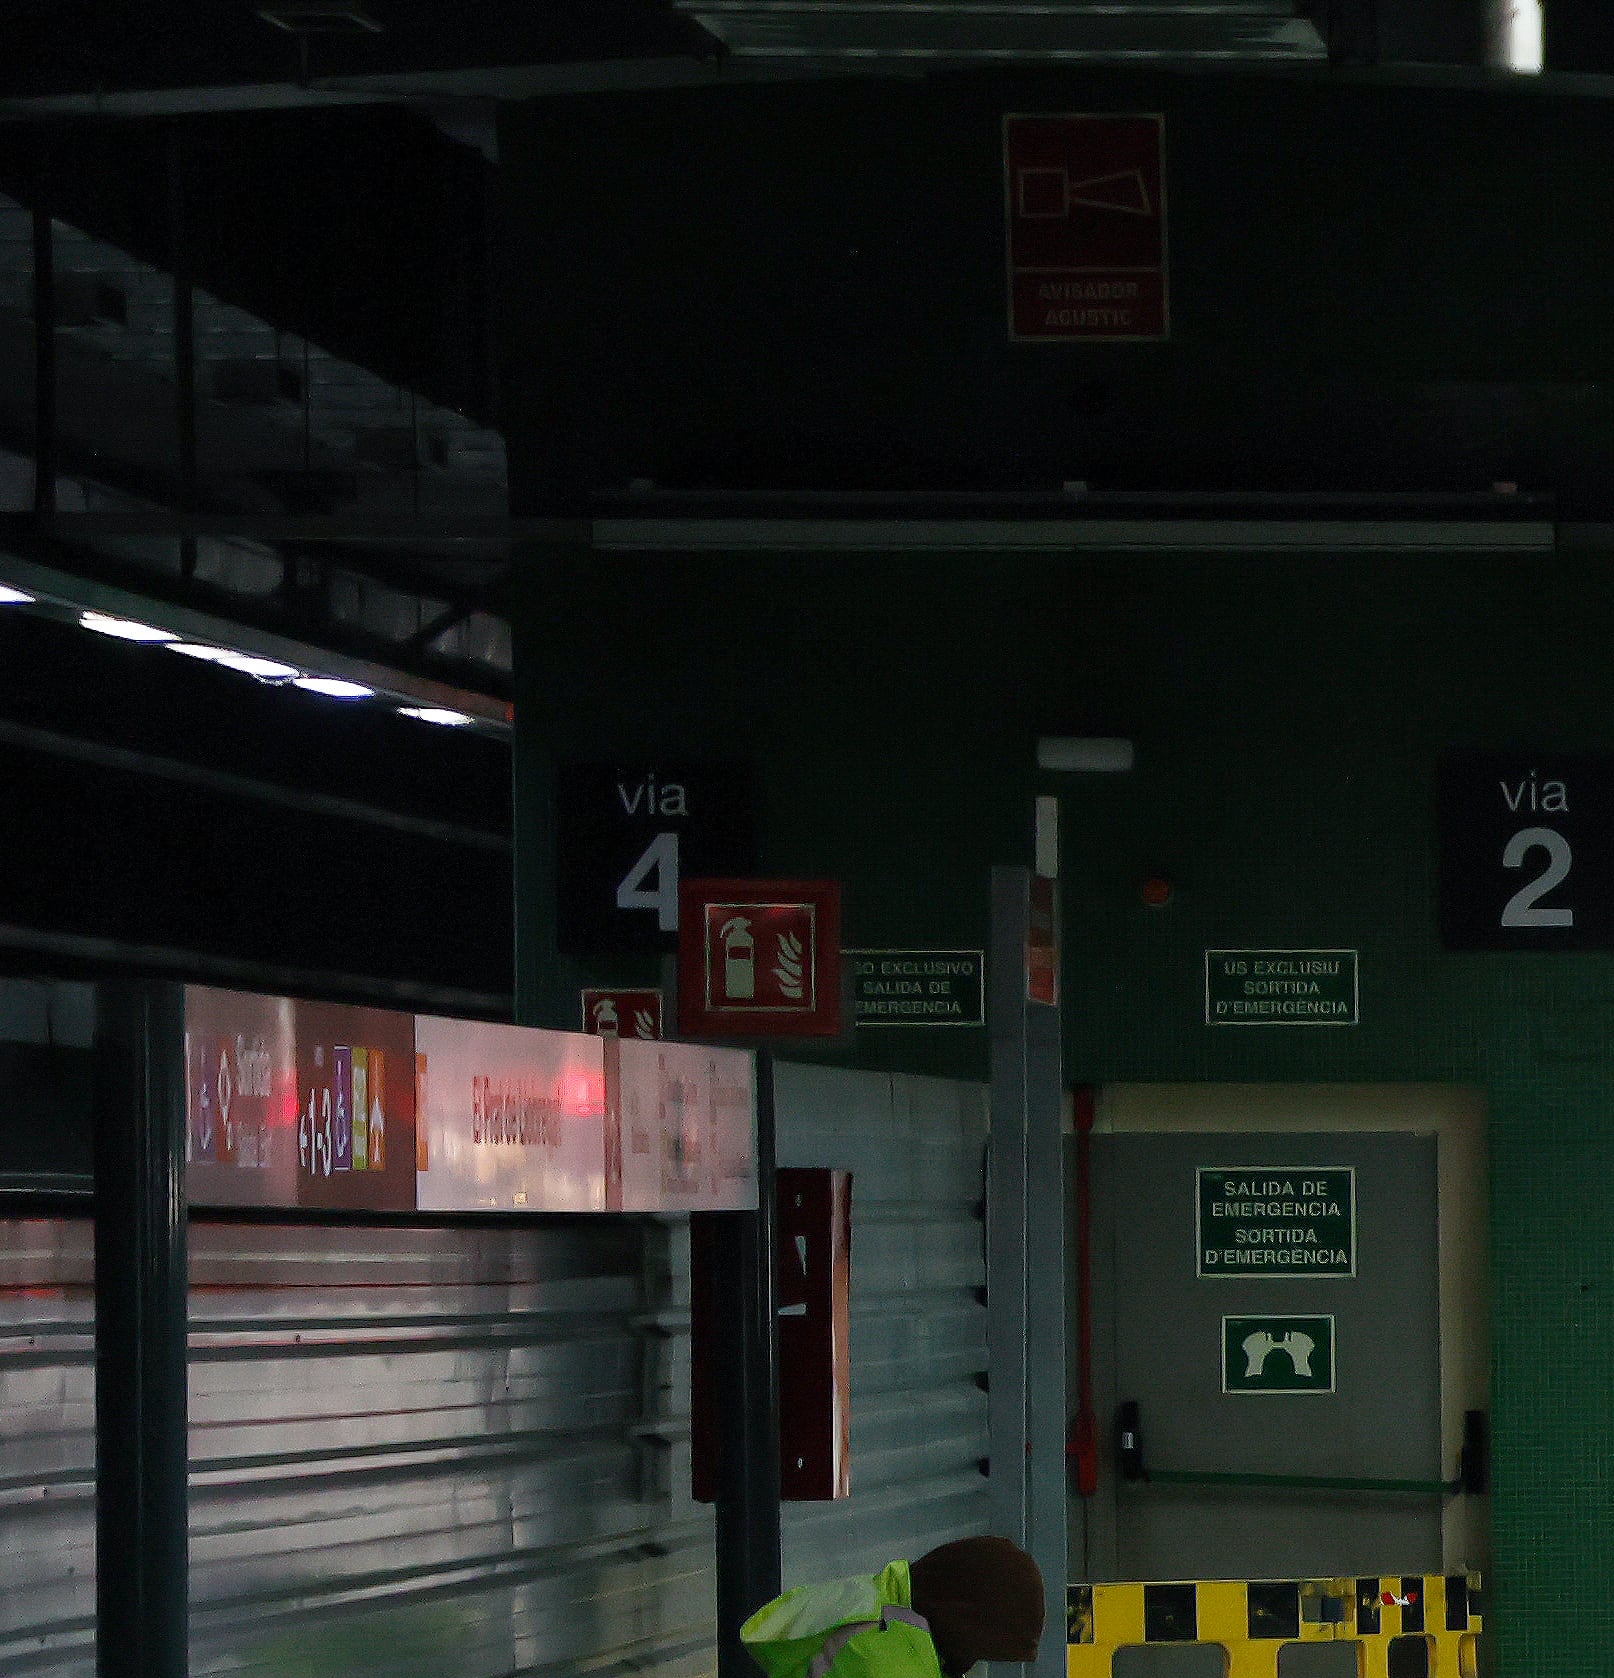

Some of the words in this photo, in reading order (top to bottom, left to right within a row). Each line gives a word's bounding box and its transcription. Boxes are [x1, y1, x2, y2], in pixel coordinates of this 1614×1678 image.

[616, 772, 690, 817] via
[1498, 769, 1570, 813] via
[616, 832, 679, 932] 4
[1500, 826, 1574, 927] 2
[880, 960, 974, 976] EXCLUSIVO
[1253, 960, 1341, 976] EXCLUSIU
[862, 980, 923, 995] SALIDA
[928, 980, 952, 995] DE
[1243, 980, 1321, 996] SORTIDA
[1223, 1180, 1295, 1197] SALIDA
[1301, 1180, 1328, 1197] DE
[1211, 1201, 1342, 1218] EMERGENCIA
[1234, 1228, 1318, 1244] SORTIDA
